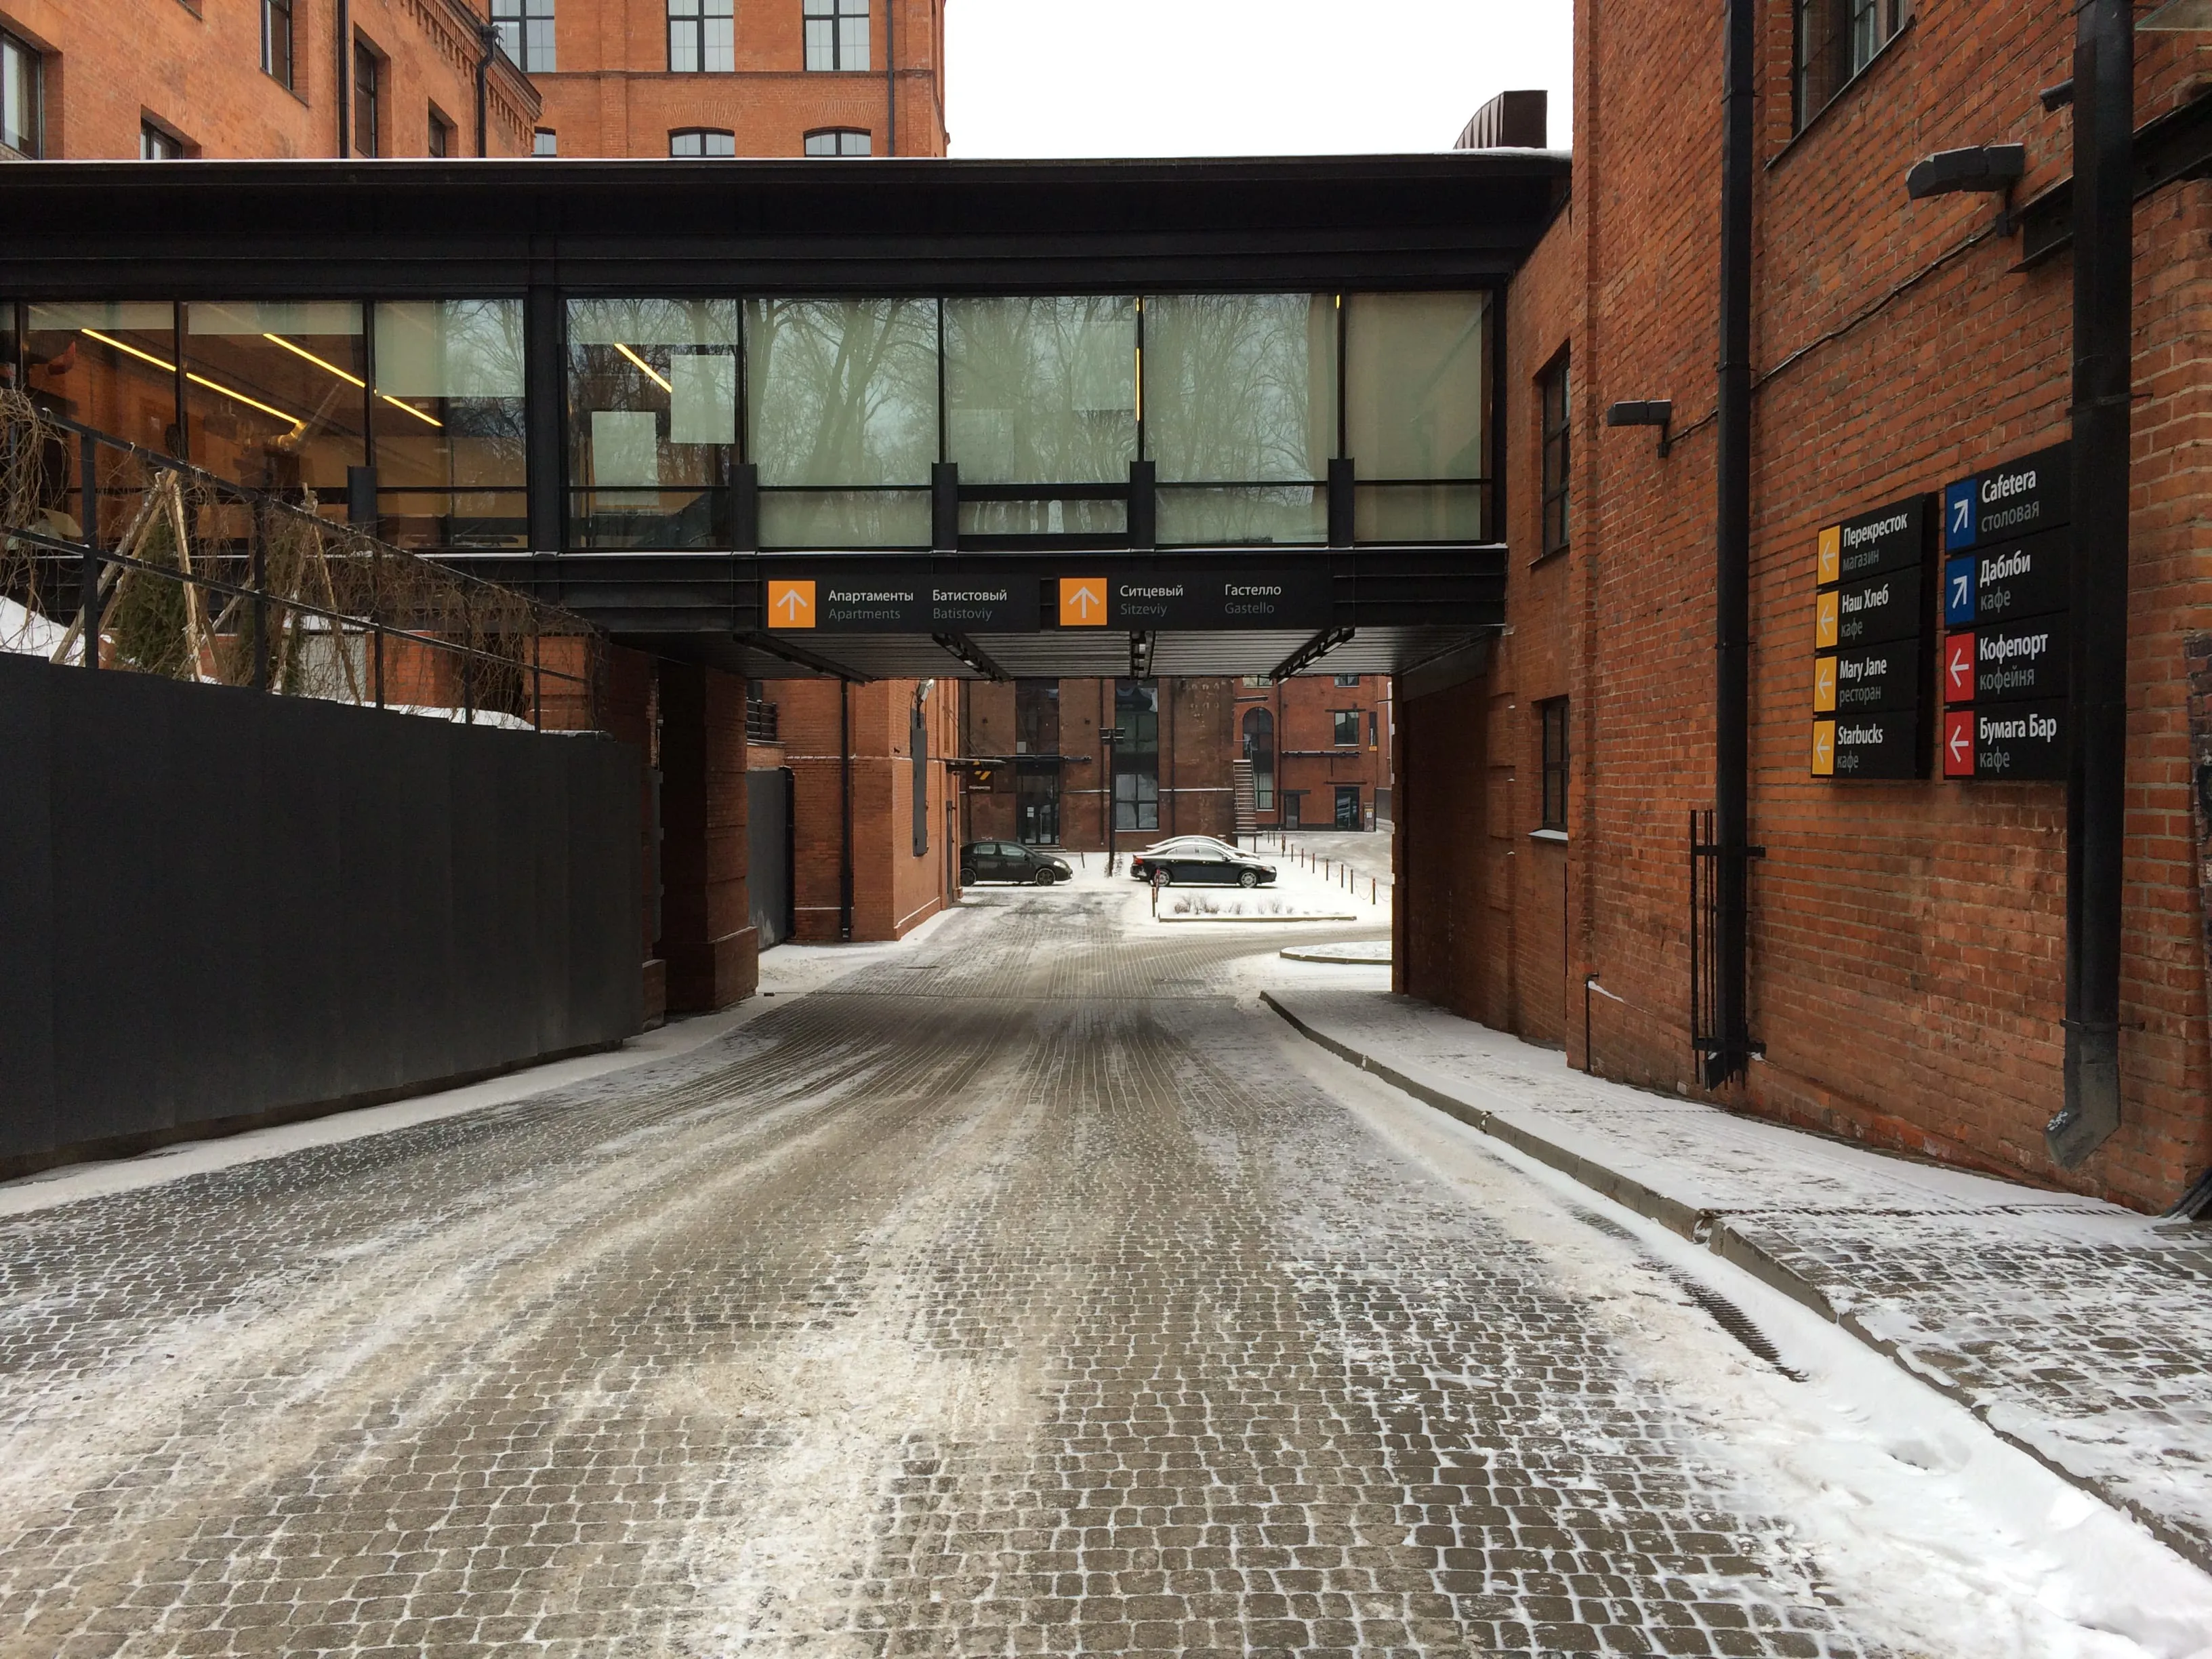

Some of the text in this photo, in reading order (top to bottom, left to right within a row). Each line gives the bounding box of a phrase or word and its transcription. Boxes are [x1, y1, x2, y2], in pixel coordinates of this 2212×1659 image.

[1982, 470, 2036, 504] Cafetera
[1981, 499, 2039, 533] столовая
[1843, 512, 1908, 548] Перекресток
[1843, 549, 1879, 572] магазин
[1980, 550, 2031, 588] Даблби
[828, 589, 1007, 604] Апартаменты Батистовый
[1120, 583, 1282, 599] Ситцевый Гастелло
[1842, 583, 1889, 613] Наш Хлеб
[1980, 586, 2011, 613] кафе
[828, 607, 993, 621] Apartments Batistoviy
[1120, 601, 1275, 617] Sitzeviy Gastello
[1841, 617, 1863, 640] кафе
[1980, 634, 2049, 665] Кофепорт
[1839, 657, 1887, 682] Mary Jane
[1980, 665, 2034, 694] кофейня
[1839, 686, 1881, 708] ресторан
[1837, 723, 1883, 745] Starbucks
[1980, 713, 2057, 745] Бумага Бар
[1837, 751, 1859, 773] кафе
[1980, 747, 2010, 773] кафе
